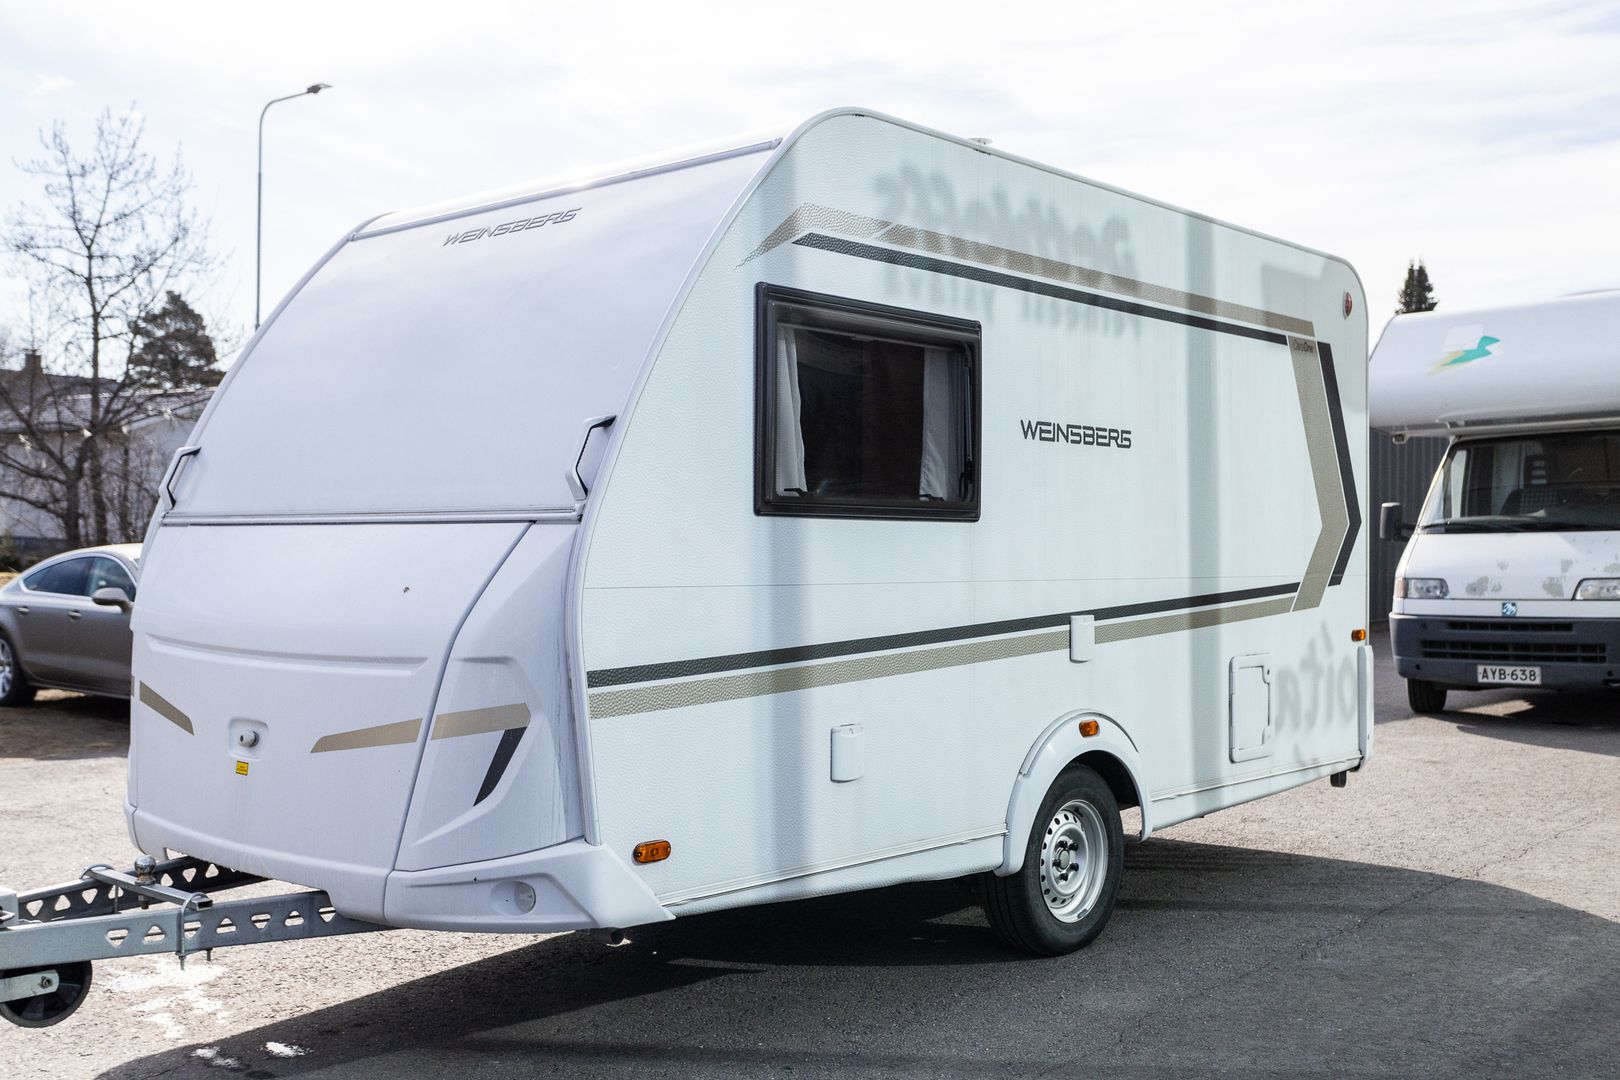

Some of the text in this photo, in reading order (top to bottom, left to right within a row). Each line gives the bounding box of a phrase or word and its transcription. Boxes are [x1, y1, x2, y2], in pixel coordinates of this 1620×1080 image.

[443, 207, 582, 246] WEINSBERG
[1020, 418, 1132, 449] WEINSBERG
[1481, 667, 1537, 682] AYB-638
